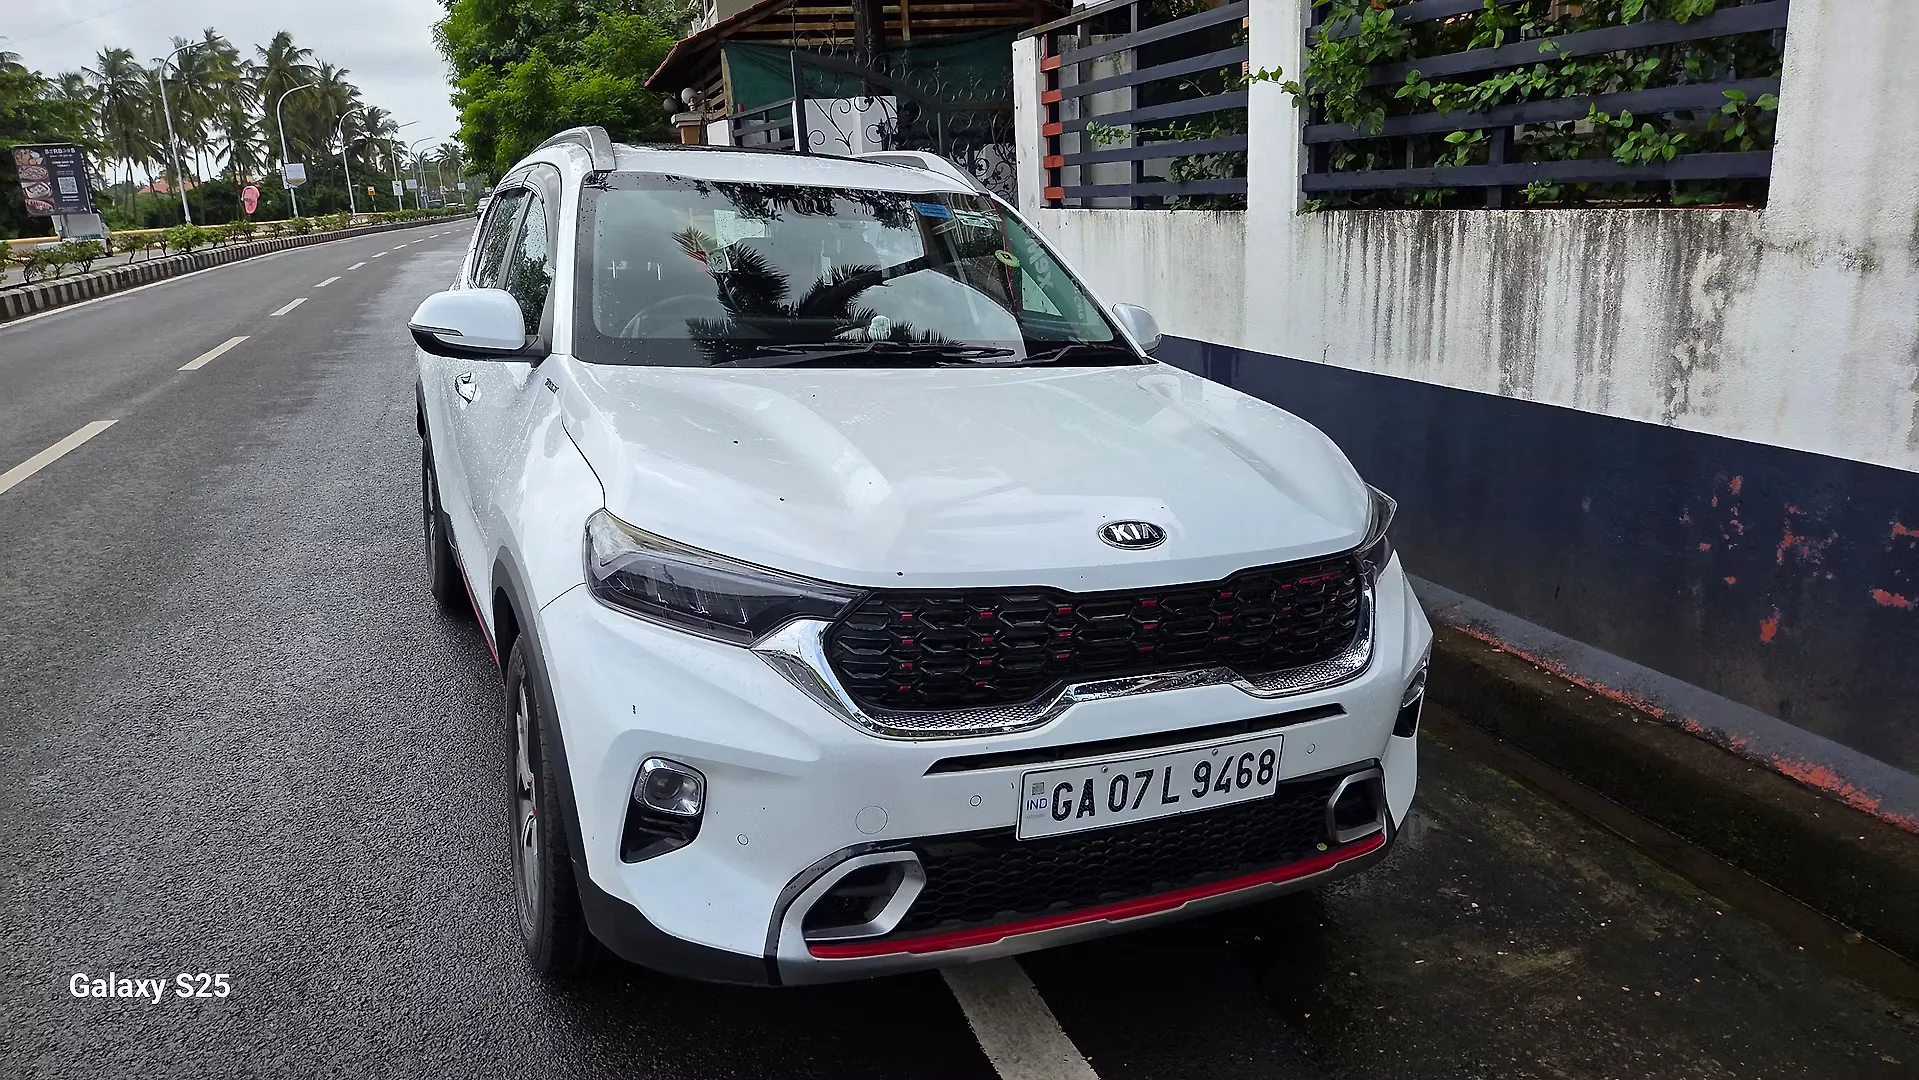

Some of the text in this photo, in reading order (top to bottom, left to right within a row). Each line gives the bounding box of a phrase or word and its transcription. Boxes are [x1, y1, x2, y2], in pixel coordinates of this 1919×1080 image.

[1109, 523, 1159, 541] KIA
[1051, 748, 1276, 822] GA 07 L 9468
[1026, 797, 1048, 811] IND
